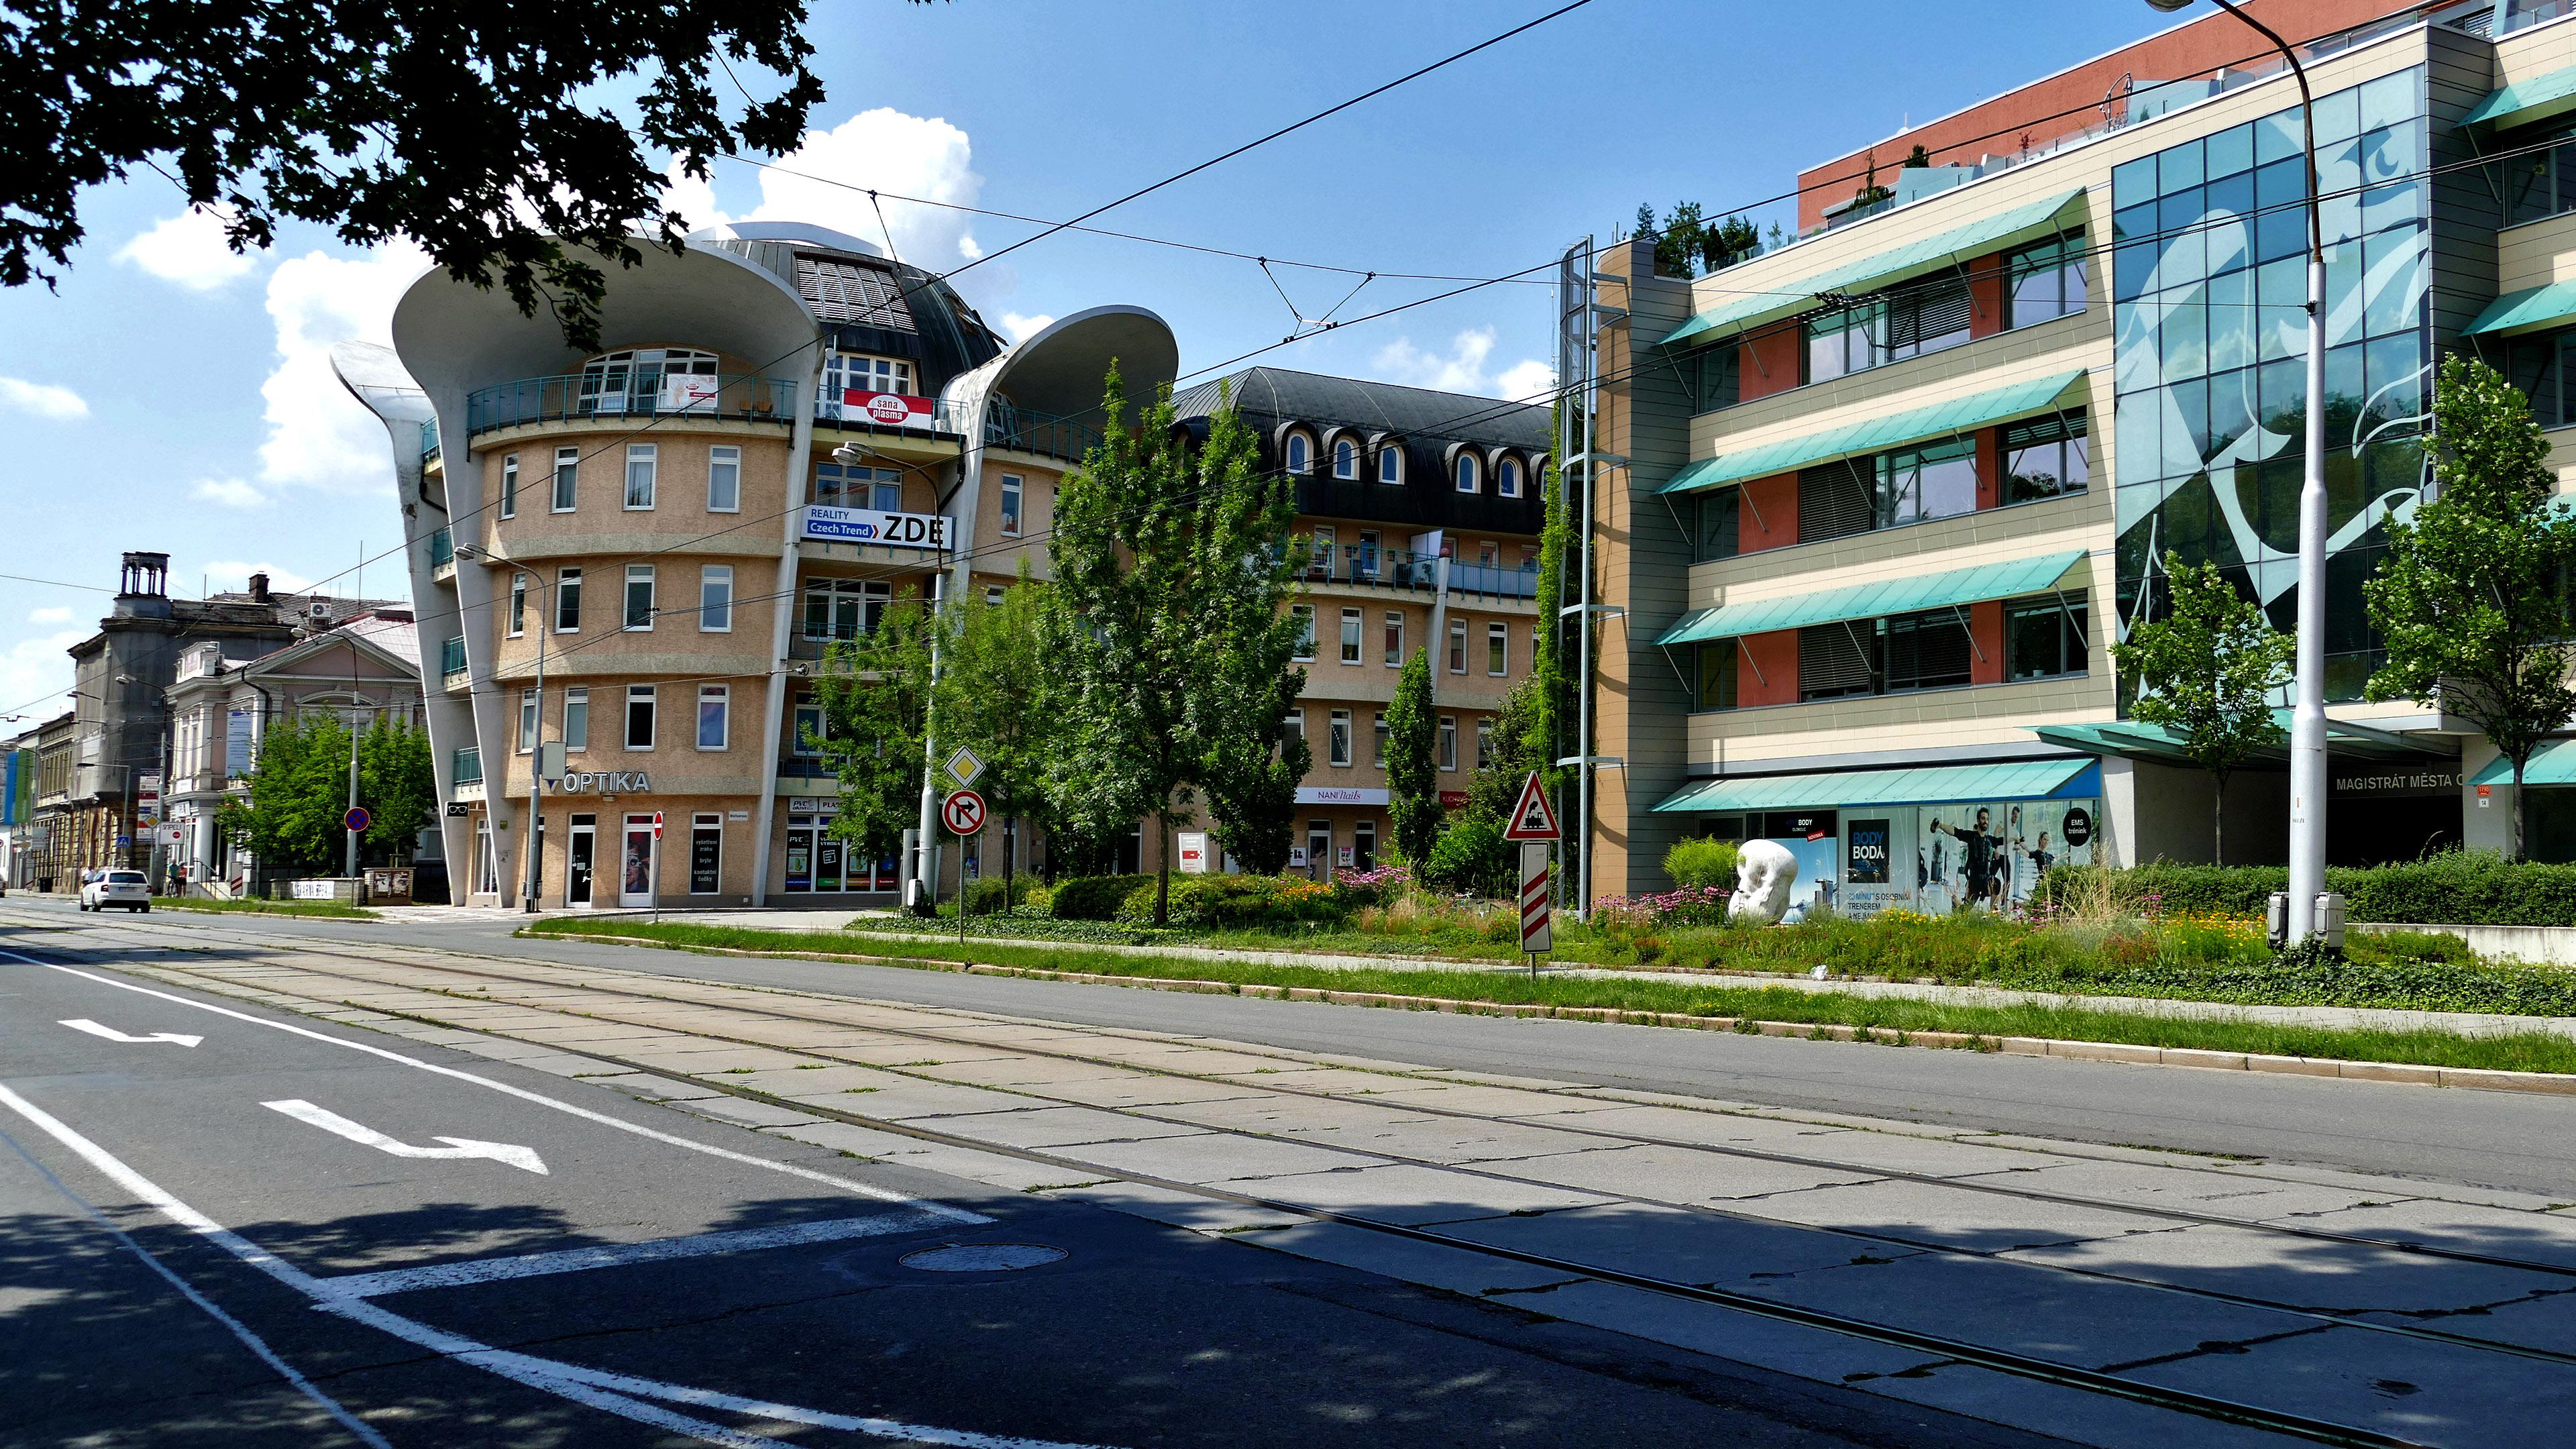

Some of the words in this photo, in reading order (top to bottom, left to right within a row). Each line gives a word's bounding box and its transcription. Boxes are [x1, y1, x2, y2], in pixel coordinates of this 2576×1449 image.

[877, 400, 898, 409] sana
[873, 409, 903, 420] plasma
[811, 508, 849, 520] REALITY
[810, 523, 839, 533] Czech
[841, 525, 869, 535] Trend
[883, 515, 944, 545] ZDE
[563, 771, 650, 792] OPTIKA
[2337, 773, 2406, 790] MAGISTRÁT
[2410, 772, 2452, 788] MĚSTA
[1807, 832, 1823, 841] NOVINKA
[1853, 831, 1884, 845] BODY
[1847, 902, 1881, 910] TRENÉREM
